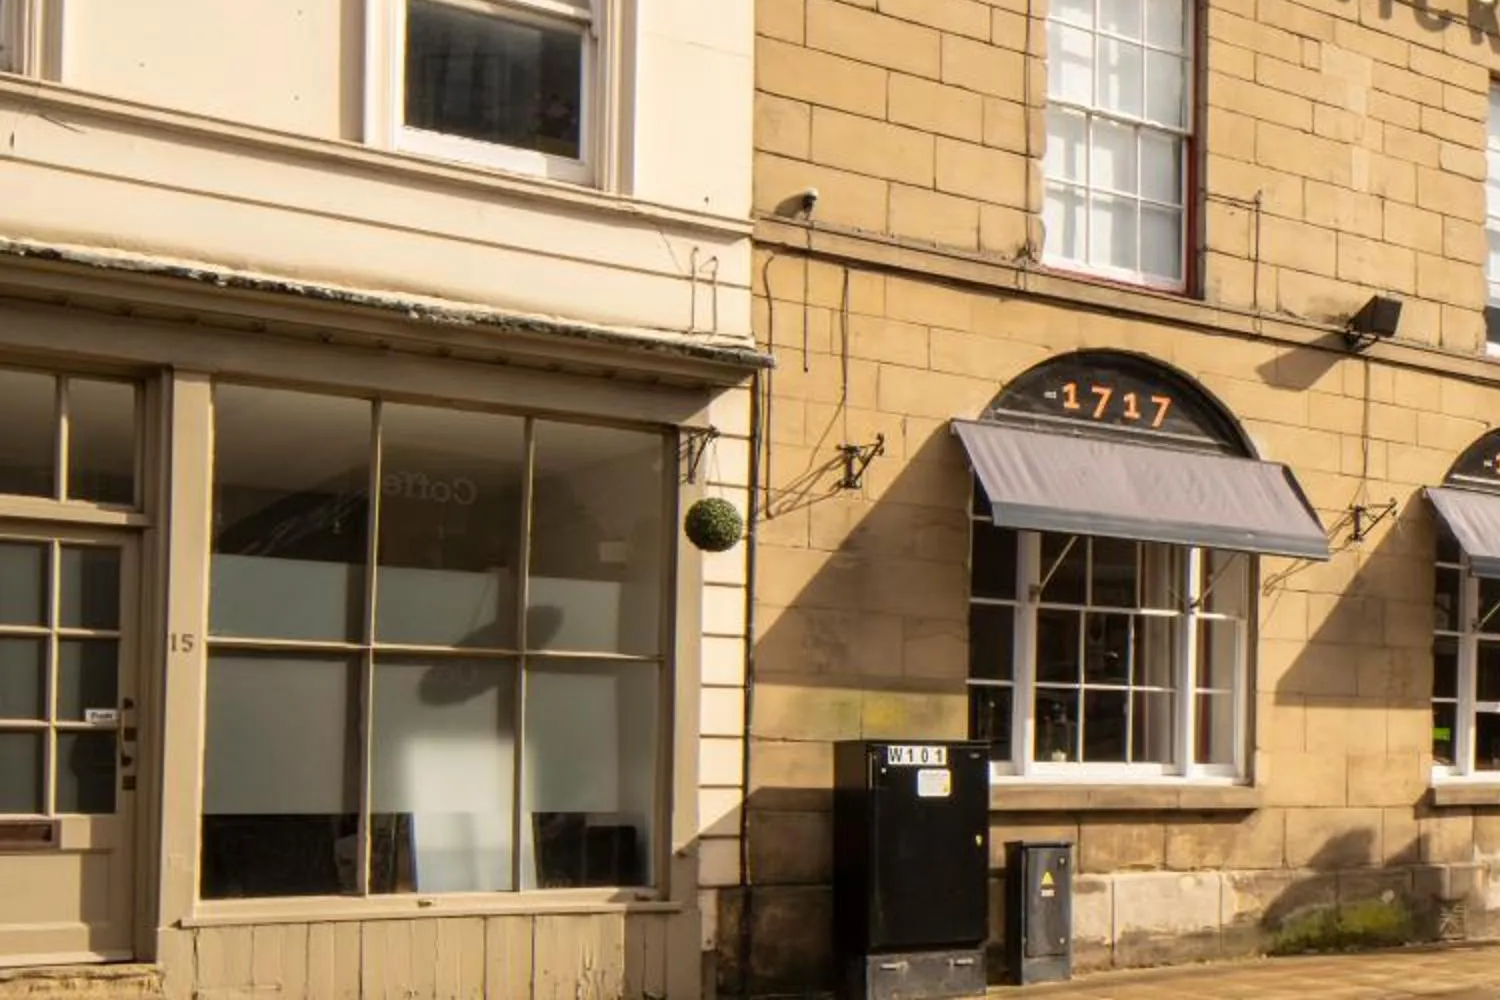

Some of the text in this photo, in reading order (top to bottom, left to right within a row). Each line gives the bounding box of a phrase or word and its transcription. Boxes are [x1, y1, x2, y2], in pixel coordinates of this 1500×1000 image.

[1062, 382, 1173, 429] 1717
[170, 633, 194, 653] 15
[890, 747, 943, 763] W101
